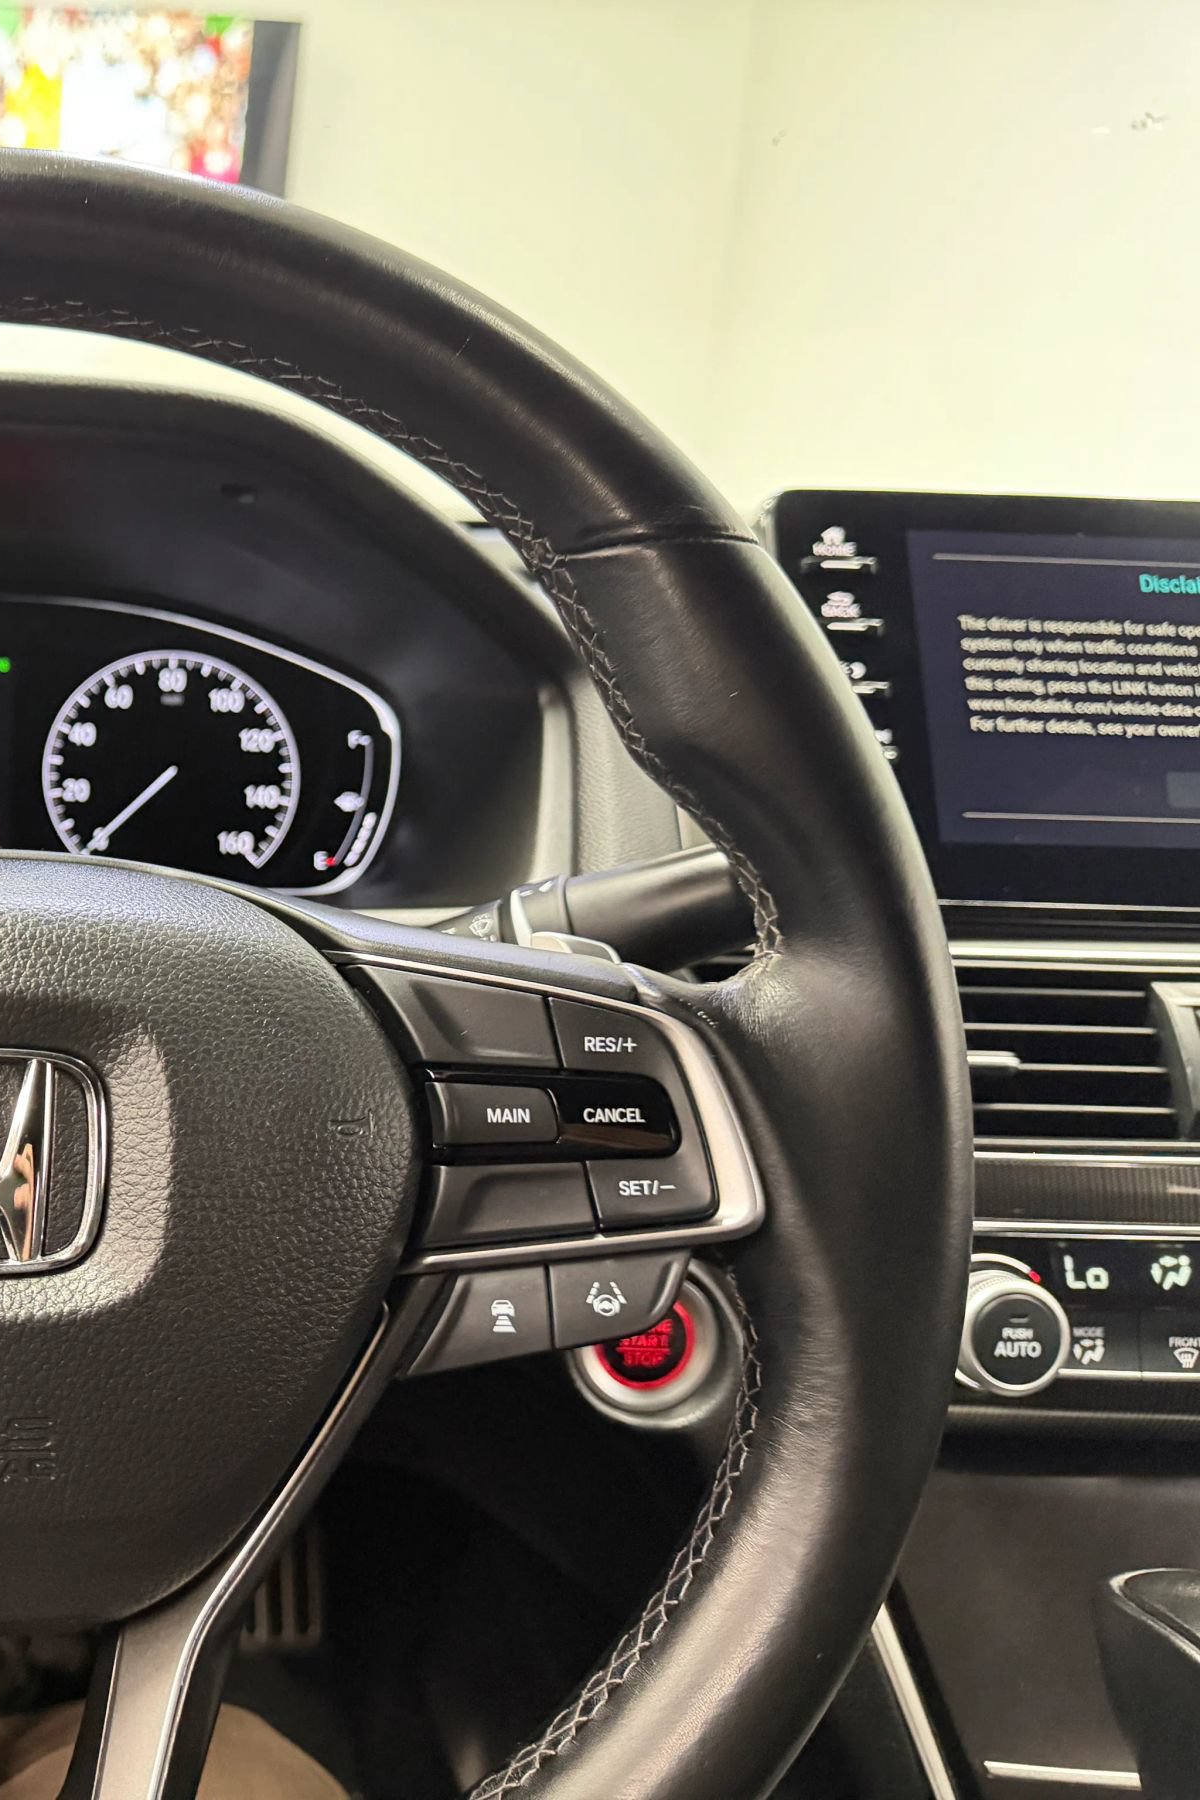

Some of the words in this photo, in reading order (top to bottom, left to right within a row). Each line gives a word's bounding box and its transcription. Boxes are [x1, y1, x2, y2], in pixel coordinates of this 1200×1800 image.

[957, 614, 987, 631] The
[987, 616, 1027, 633] driver
[1028, 618, 1042, 633] is
[1042, 620, 1123, 637] responsible
[1123, 620, 1145, 636] for
[1146, 621, 1177, 637] safe
[960, 637, 1013, 654] system
[1013, 638, 1044, 656] only
[1043, 639, 1083, 654] when
[1083, 640, 1126, 655] traffic
[1126, 642, 1198, 658] conditions
[962, 657, 1025, 675] currently
[1025, 658, 1078, 677] sharing
[1078, 659, 1135, 675] location
[1135, 661, 1163, 677] and
[158, 667, 188, 693] 80
[964, 676, 994, 692] this
[1046, 680, 1088, 696] press
[1087, 679, 1112, 695] the
[1112, 681, 1148, 697] LINK
[1147, 681, 1194, 697] button
[104, 684, 134, 710] 60
[208, 687, 246, 714] 100
[68, 721, 97, 747] 40
[970, 716, 995, 732] For
[995, 716, 1045, 733] further
[1096, 722, 1124, 736] see
[1124, 723, 1157, 739] your
[238, 727, 276, 753] 120
[62, 777, 91, 803] 20
[244, 784, 281, 809] 140
[217, 831, 254, 856] 160
[584, 1036, 638, 1053] RES/+
[487, 1108, 531, 1123] MAIN
[583, 1107, 646, 1123] CANCEL
[1063, 1254, 1110, 1290] Lo
[1001, 1327, 1034, 1340] PUSH
[623, 1352, 666, 1368] STOP
[993, 1341, 1042, 1358] AUTO
